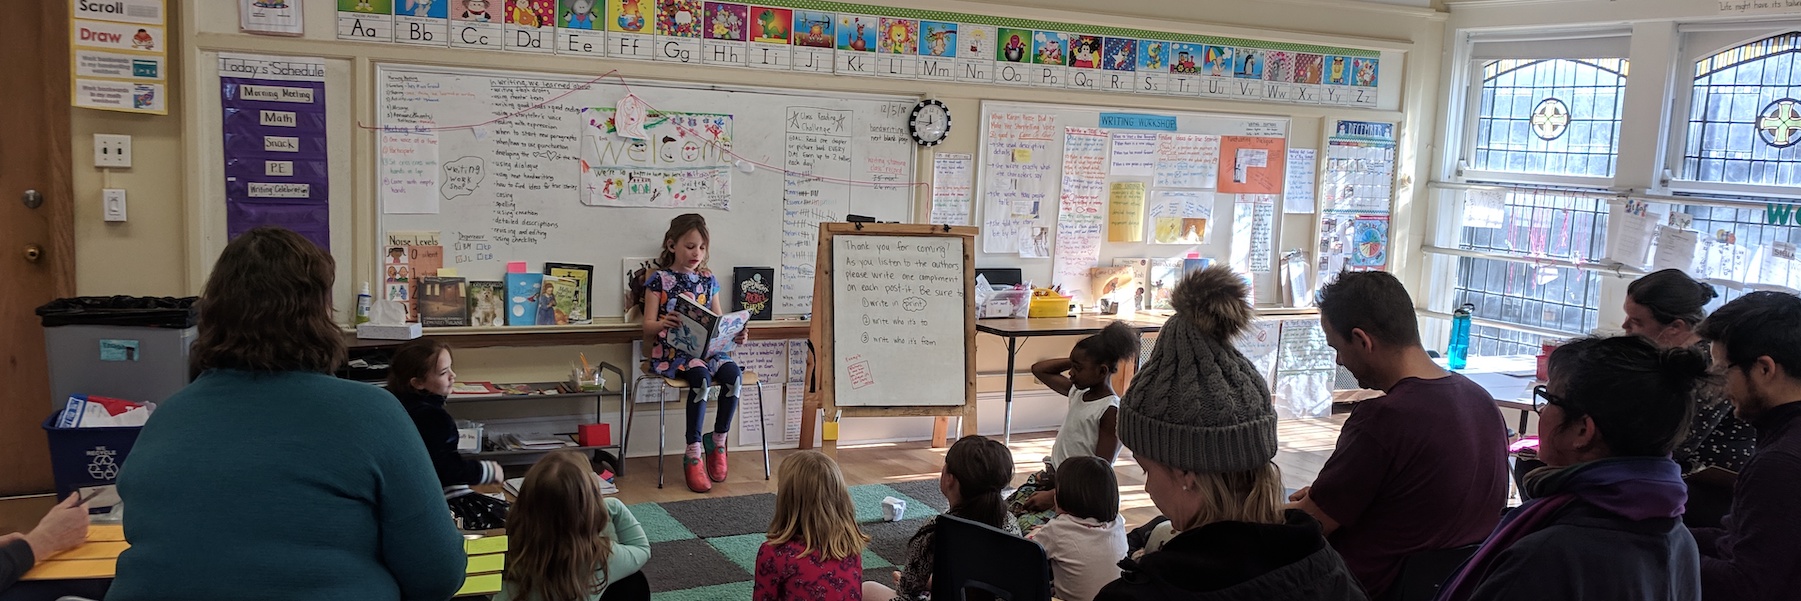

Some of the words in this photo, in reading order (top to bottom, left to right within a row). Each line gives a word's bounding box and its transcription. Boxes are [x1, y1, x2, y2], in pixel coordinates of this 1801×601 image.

[79, 0, 124, 14] Scroll
[1754, 1, 1768, 9] have
[80, 27, 122, 43] Draw
[351, 19, 376, 38] Aa
[410, 23, 433, 41] Bb
[461, 27, 489, 45] Cc
[517, 30, 541, 48] Dd
[568, 34, 593, 53] Ee
[620, 38, 639, 55] Ff
[664, 41, 690, 62] Gg
[714, 45, 738, 62] Hh
[805, 52, 819, 70] Jj
[847, 55, 864, 72] Kk
[223, 58, 268, 79] Today's
[271, 61, 324, 77] Schedule
[923, 61, 949, 77] Mm
[965, 63, 984, 79] Nn
[1001, 65, 1021, 82] Oo
[1042, 69, 1058, 85] Pp
[1074, 71, 1093, 88] Qq
[1111, 74, 1124, 89] Rr
[1144, 76, 1158, 91] Ss
[542, 81, 570, 89] learned
[1178, 78, 1190, 92] Tt
[1209, 80, 1223, 95] Uu
[1239, 82, 1254, 96] Vv
[1267, 84, 1286, 99] Ww
[244, 86, 279, 99] Morning
[282, 88, 311, 102] Meeting
[1298, 87, 1312, 101] Xx
[1328, 88, 1341, 103] Yy
[1356, 90, 1370, 103] Zz
[265, 112, 293, 123] Math
[1101, 116, 1134, 126] WRITING
[1139, 118, 1175, 128] WORKSHOP
[527, 122, 558, 130] expression
[801, 123, 831, 133] Challenge
[870, 123, 904, 136] handwriting
[1348, 122, 1382, 137] DECEMBER
[265, 137, 295, 149] Snack
[898, 136, 908, 144] page
[586, 133, 732, 165] Welcome
[496, 161, 512, 171] using
[514, 161, 539, 171] dialogue
[594, 168, 615, 178] We're
[496, 172, 508, 180] using
[523, 173, 554, 181] handwriting
[250, 185, 272, 196] Writing
[273, 184, 308, 194] Celebration
[495, 201, 516, 211] spelling
[496, 210, 514, 218] using
[495, 217, 519, 225] detailed
[522, 219, 559, 229] descriptions
[389, 235, 411, 246] Noise
[493, 228, 516, 237] revising
[528, 229, 547, 239] editing
[511, 236, 538, 245] checklists
[411, 248, 418, 260] 0
[845, 240, 869, 250] Thank
[876, 244, 890, 254] you
[897, 240, 909, 251] for
[917, 242, 950, 258] coming!
[846, 257, 856, 266] As
[859, 259, 874, 268] you
[878, 257, 901, 266] listen
[904, 258, 911, 267] to
[411, 267, 416, 279] 1
[845, 271, 868, 281] please
[871, 271, 894, 280] write
[918, 274, 958, 283] compliment
[411, 285, 418, 299] 2
[861, 283, 879, 291] each
[885, 283, 915, 294] post-it.
[919, 285, 931, 295] Be
[935, 289, 953, 297] sure
[956, 288, 963, 297] to
[905, 301, 922, 309] print
[872, 317, 889, 325] write
[893, 316, 904, 325] who
[893, 336, 905, 344] who
[921, 335, 936, 346] from
